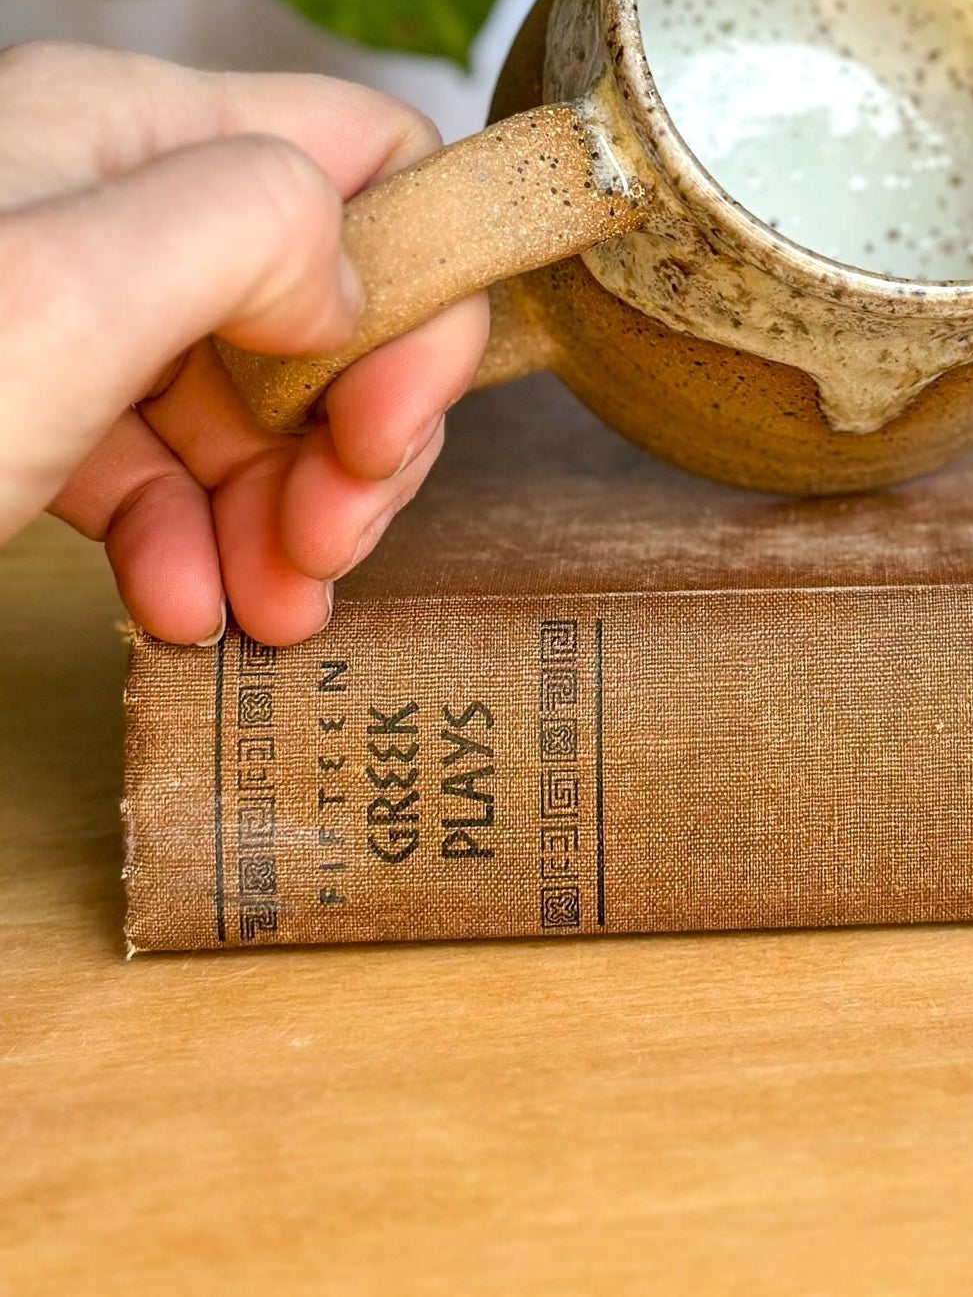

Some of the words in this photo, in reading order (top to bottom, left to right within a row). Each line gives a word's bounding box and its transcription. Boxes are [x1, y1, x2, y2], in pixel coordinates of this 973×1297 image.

[318, 660, 348, 904] FIFTEEN
[366, 701, 419, 863] GREEK
[440, 702, 495, 858] PLAYS
